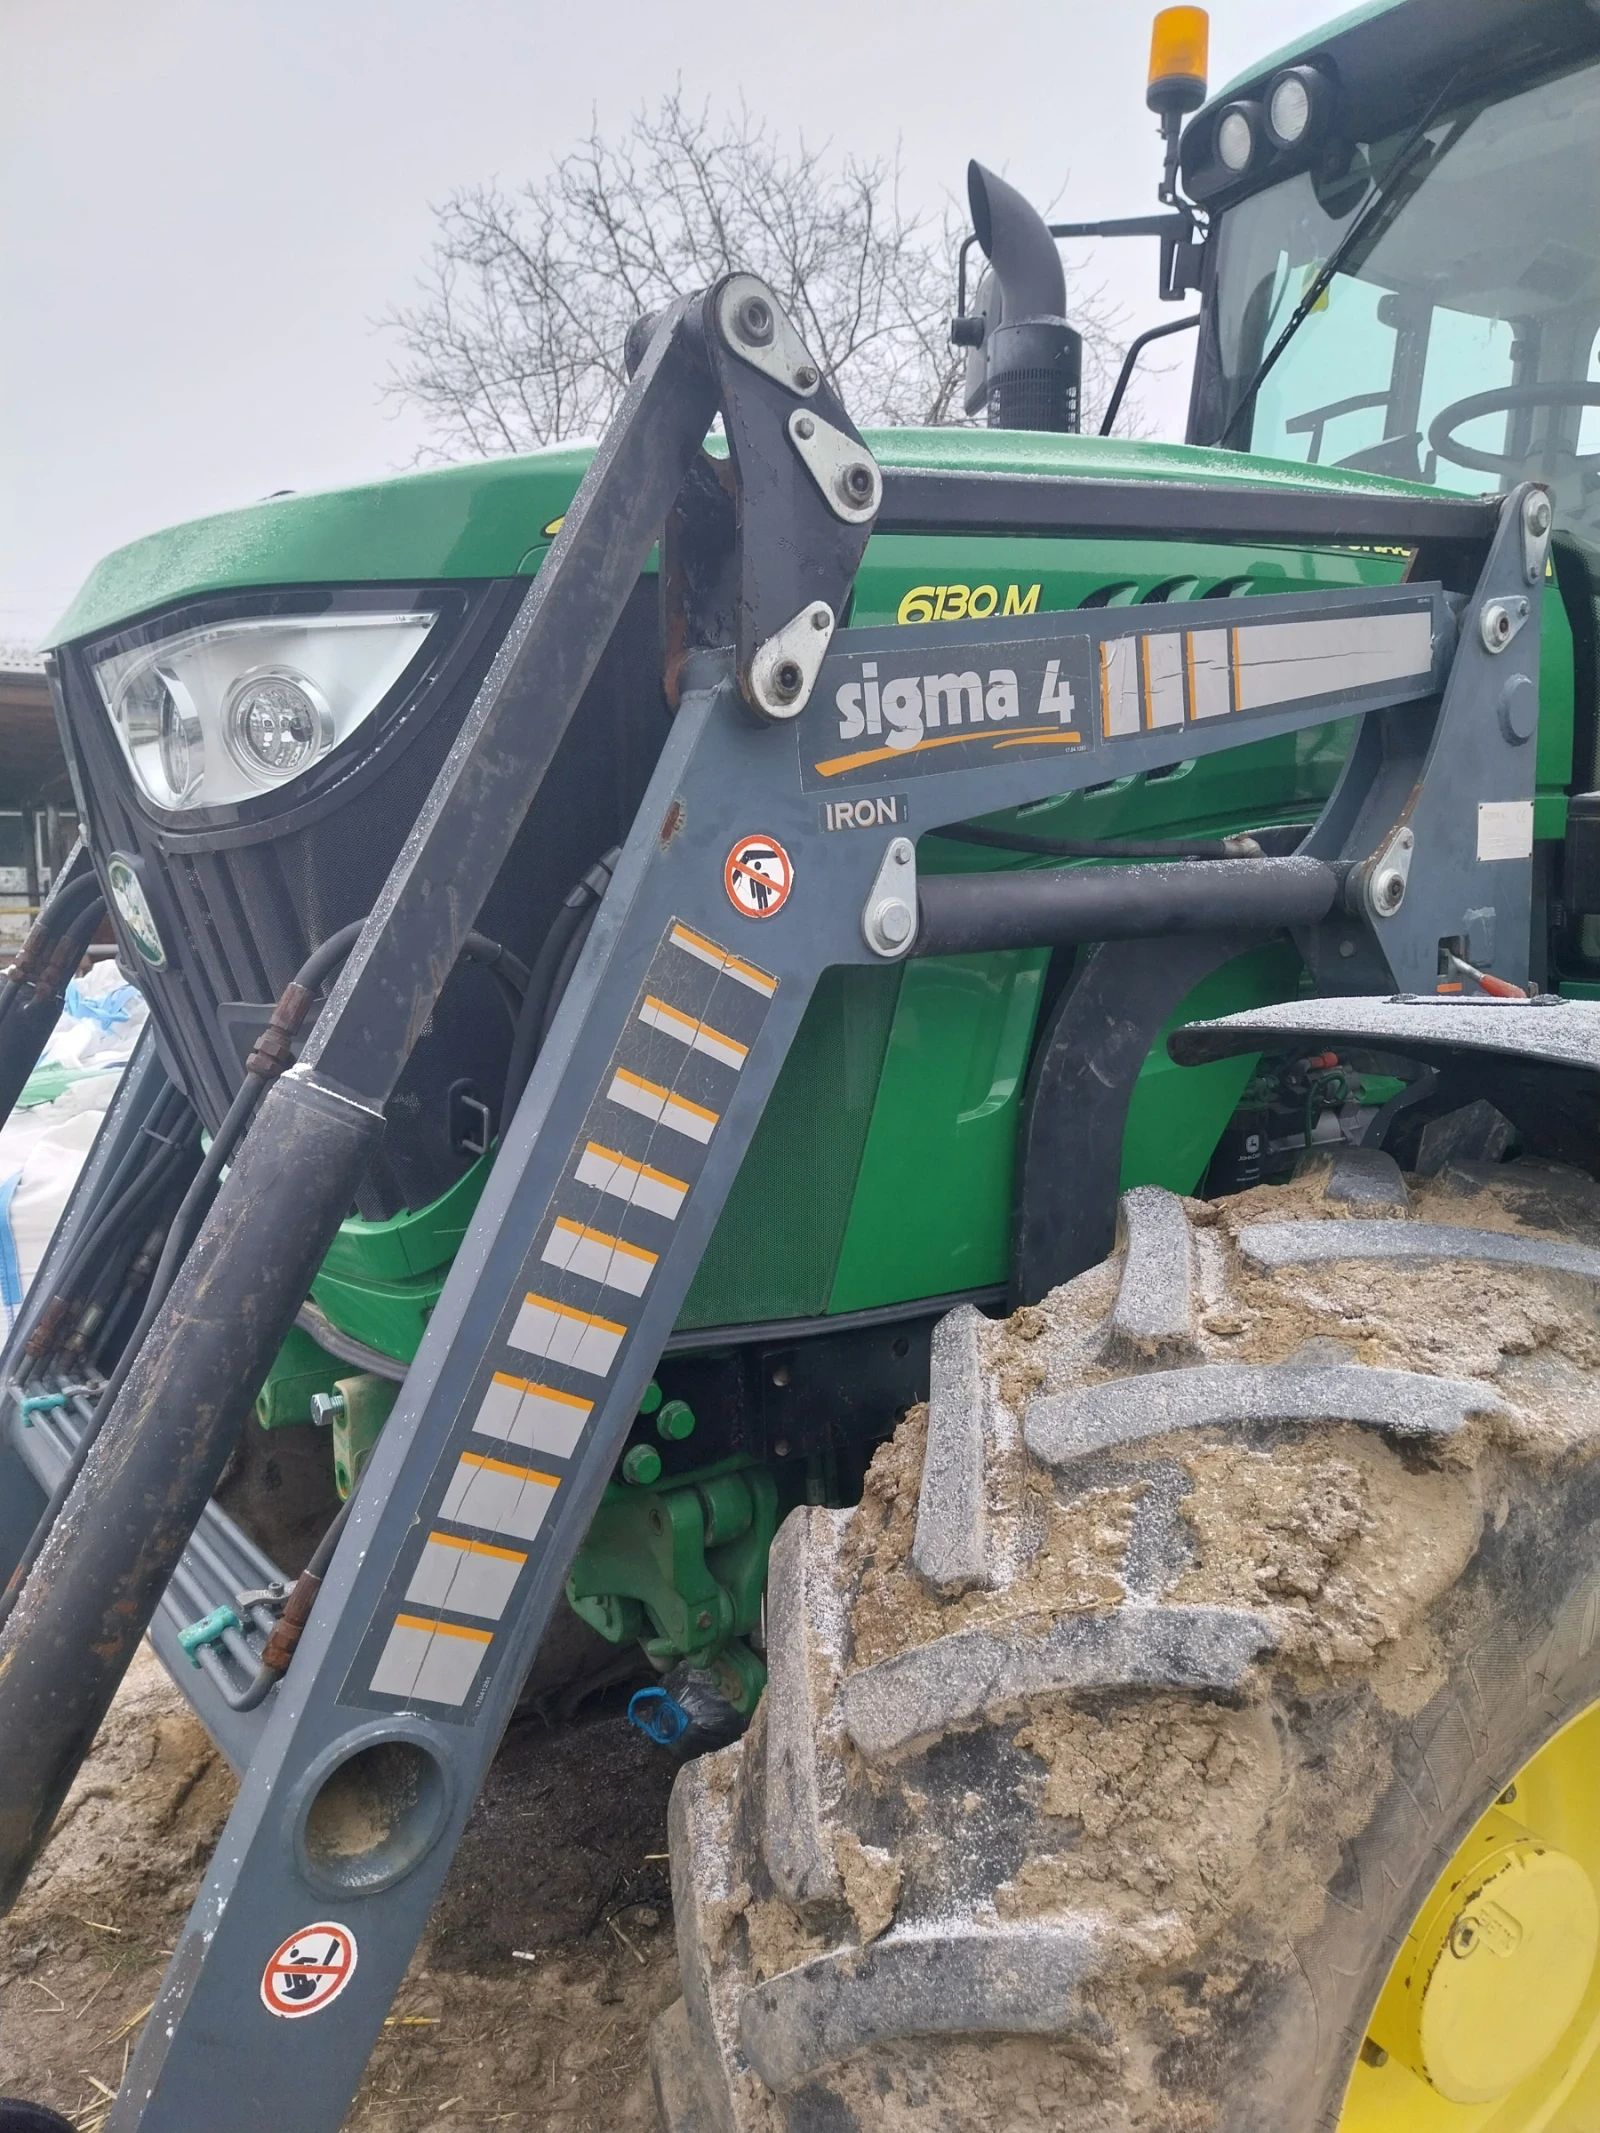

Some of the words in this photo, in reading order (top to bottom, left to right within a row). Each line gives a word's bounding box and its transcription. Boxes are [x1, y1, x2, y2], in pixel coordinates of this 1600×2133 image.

[835, 661, 1020, 750] sigma
[1038, 659, 1076, 724] 4
[825, 796, 898, 831] IRON
